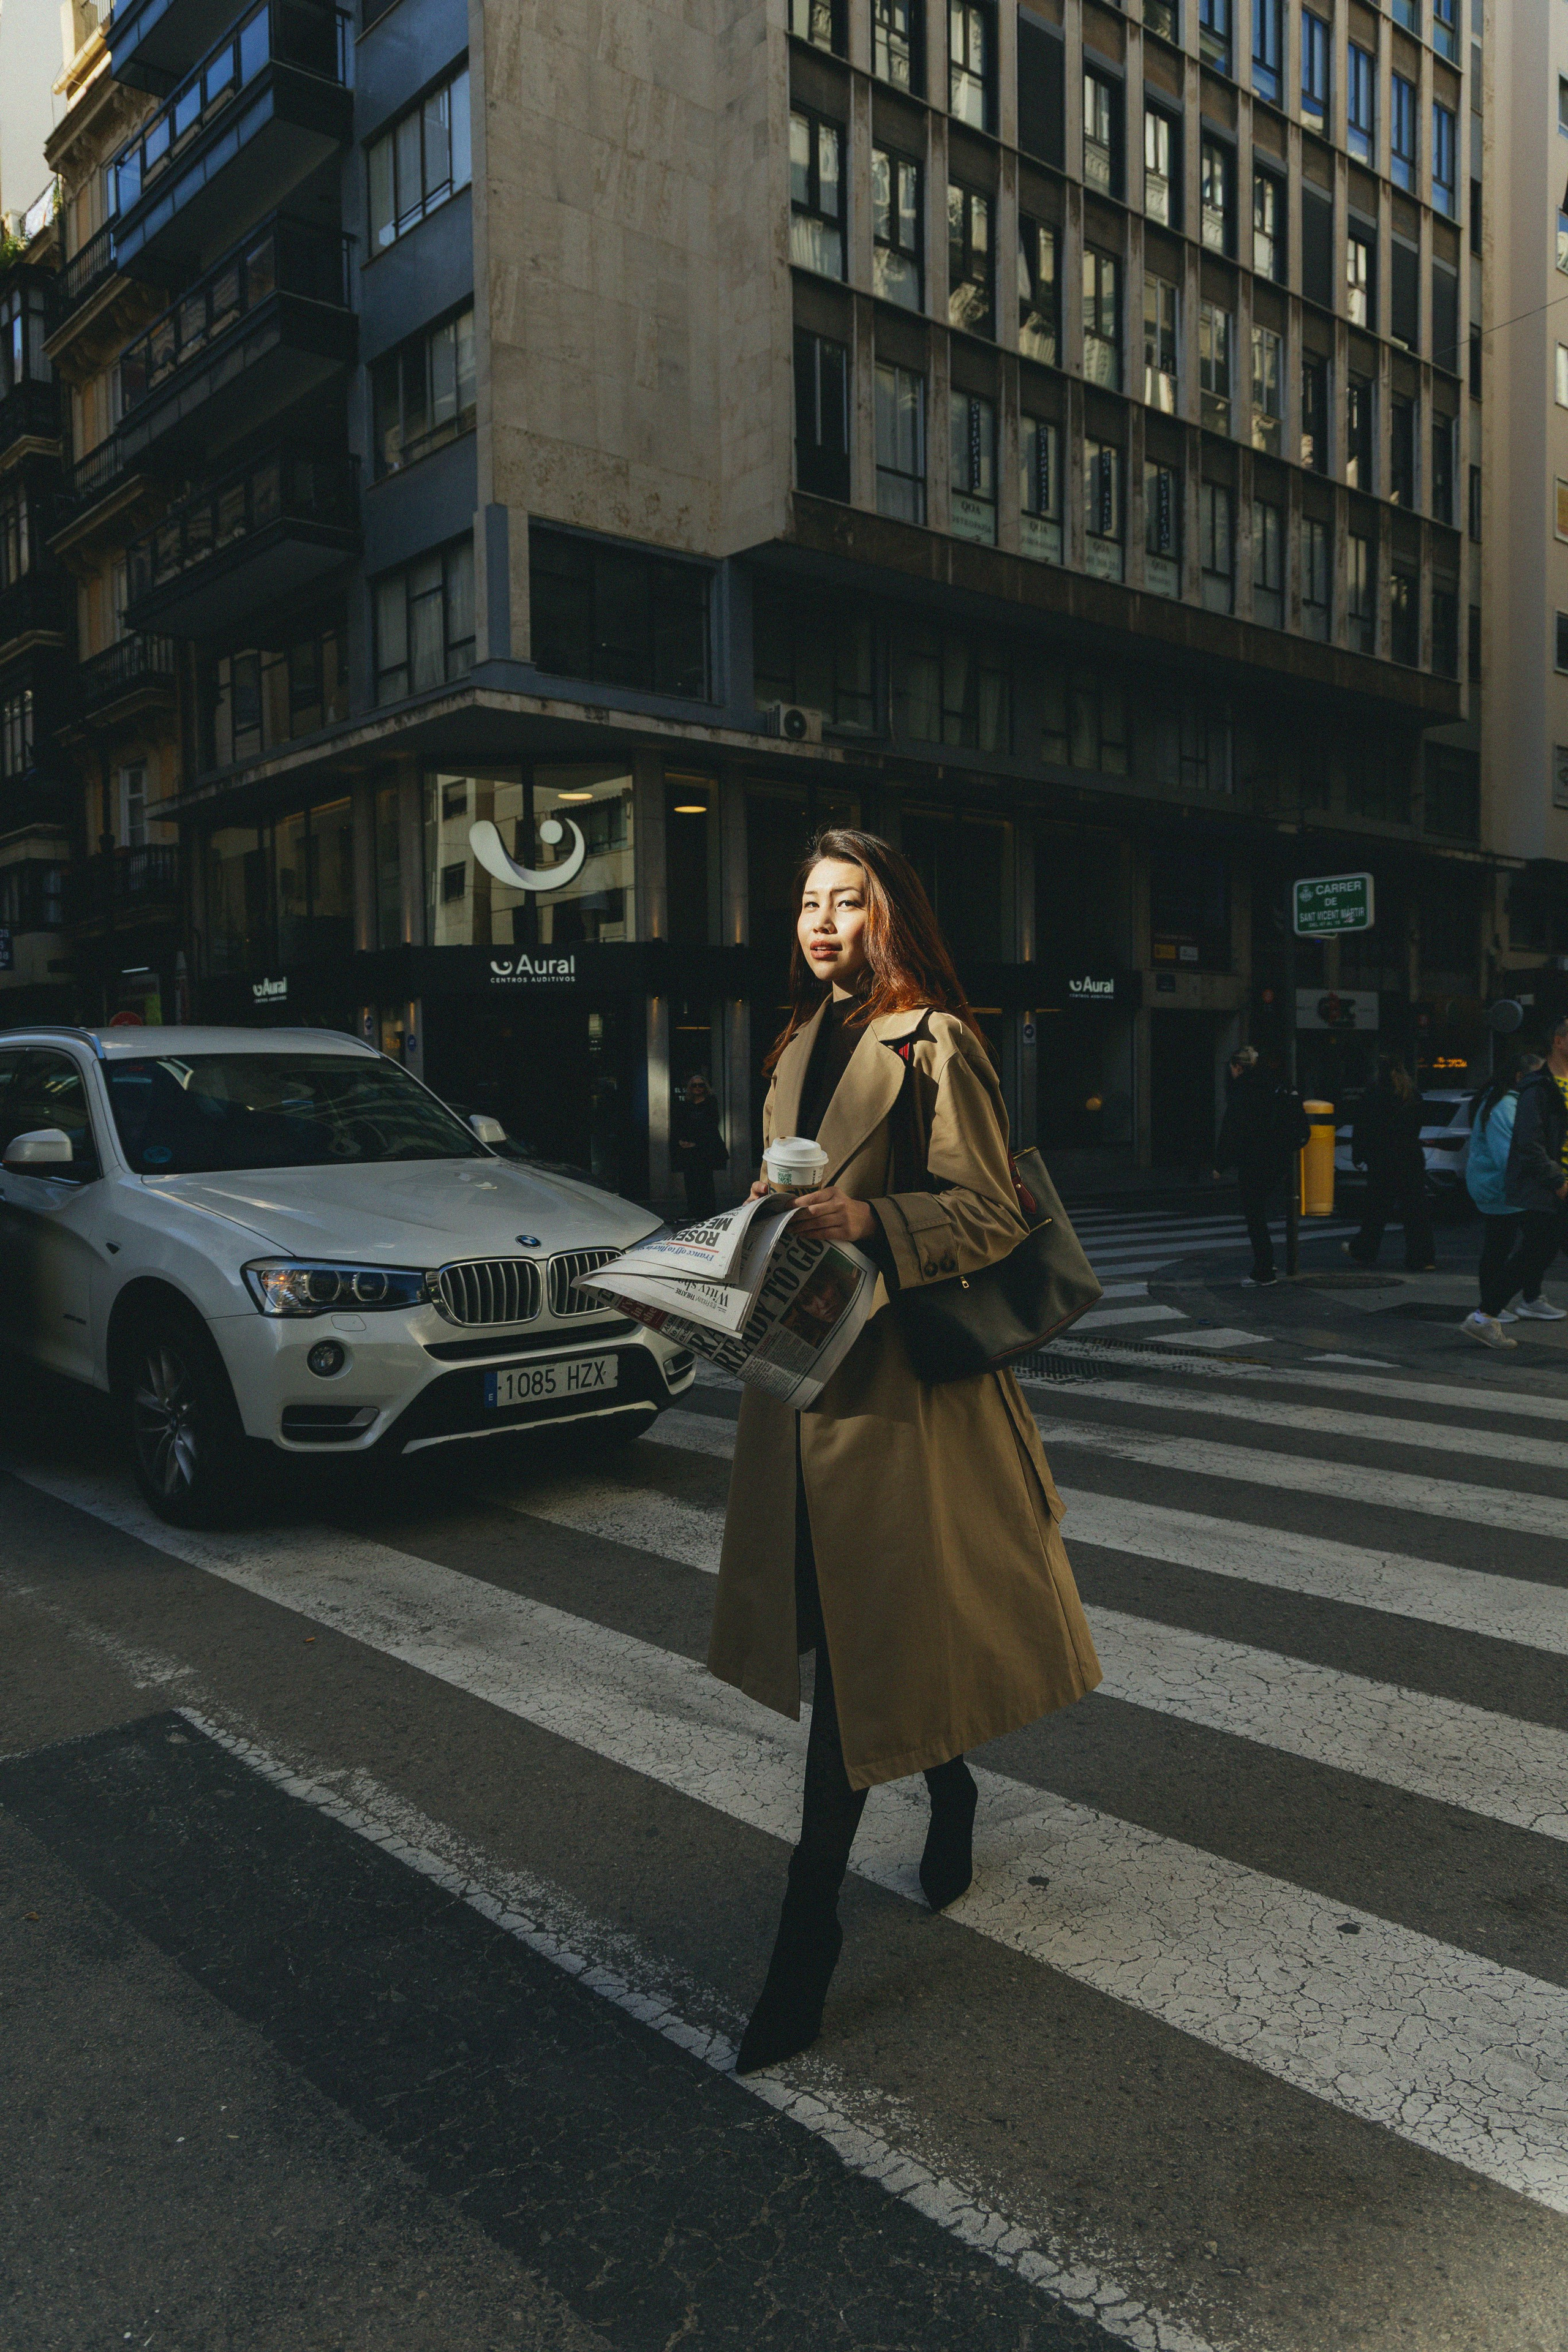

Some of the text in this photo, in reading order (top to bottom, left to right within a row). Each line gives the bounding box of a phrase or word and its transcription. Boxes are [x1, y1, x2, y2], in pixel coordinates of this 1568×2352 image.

[1316, 881, 1362, 895] CARRER
[1324, 897, 1338, 907] DE
[1300, 911, 1316, 922] SANT
[1317, 909, 1340, 921] VICENT
[516, 954, 575, 974] Aural
[262, 976, 287, 995] Aural
[1083, 976, 1114, 993] Aural
[673, 1245, 687, 1255] off
[686, 1250, 715, 1261] France
[675, 1288, 696, 1300] THEATRE
[699, 1283, 729, 1308] Witty
[695, 1295, 711, 1307] Friday!
[714, 1303, 778, 1375] READY
[761, 1266, 800, 1305] TO
[786, 1235, 824, 1272] GO
[663, 1322, 672, 1332] As
[506, 1360, 605, 1400] 1085 HZX
[488, 1393, 494, 1401] E
